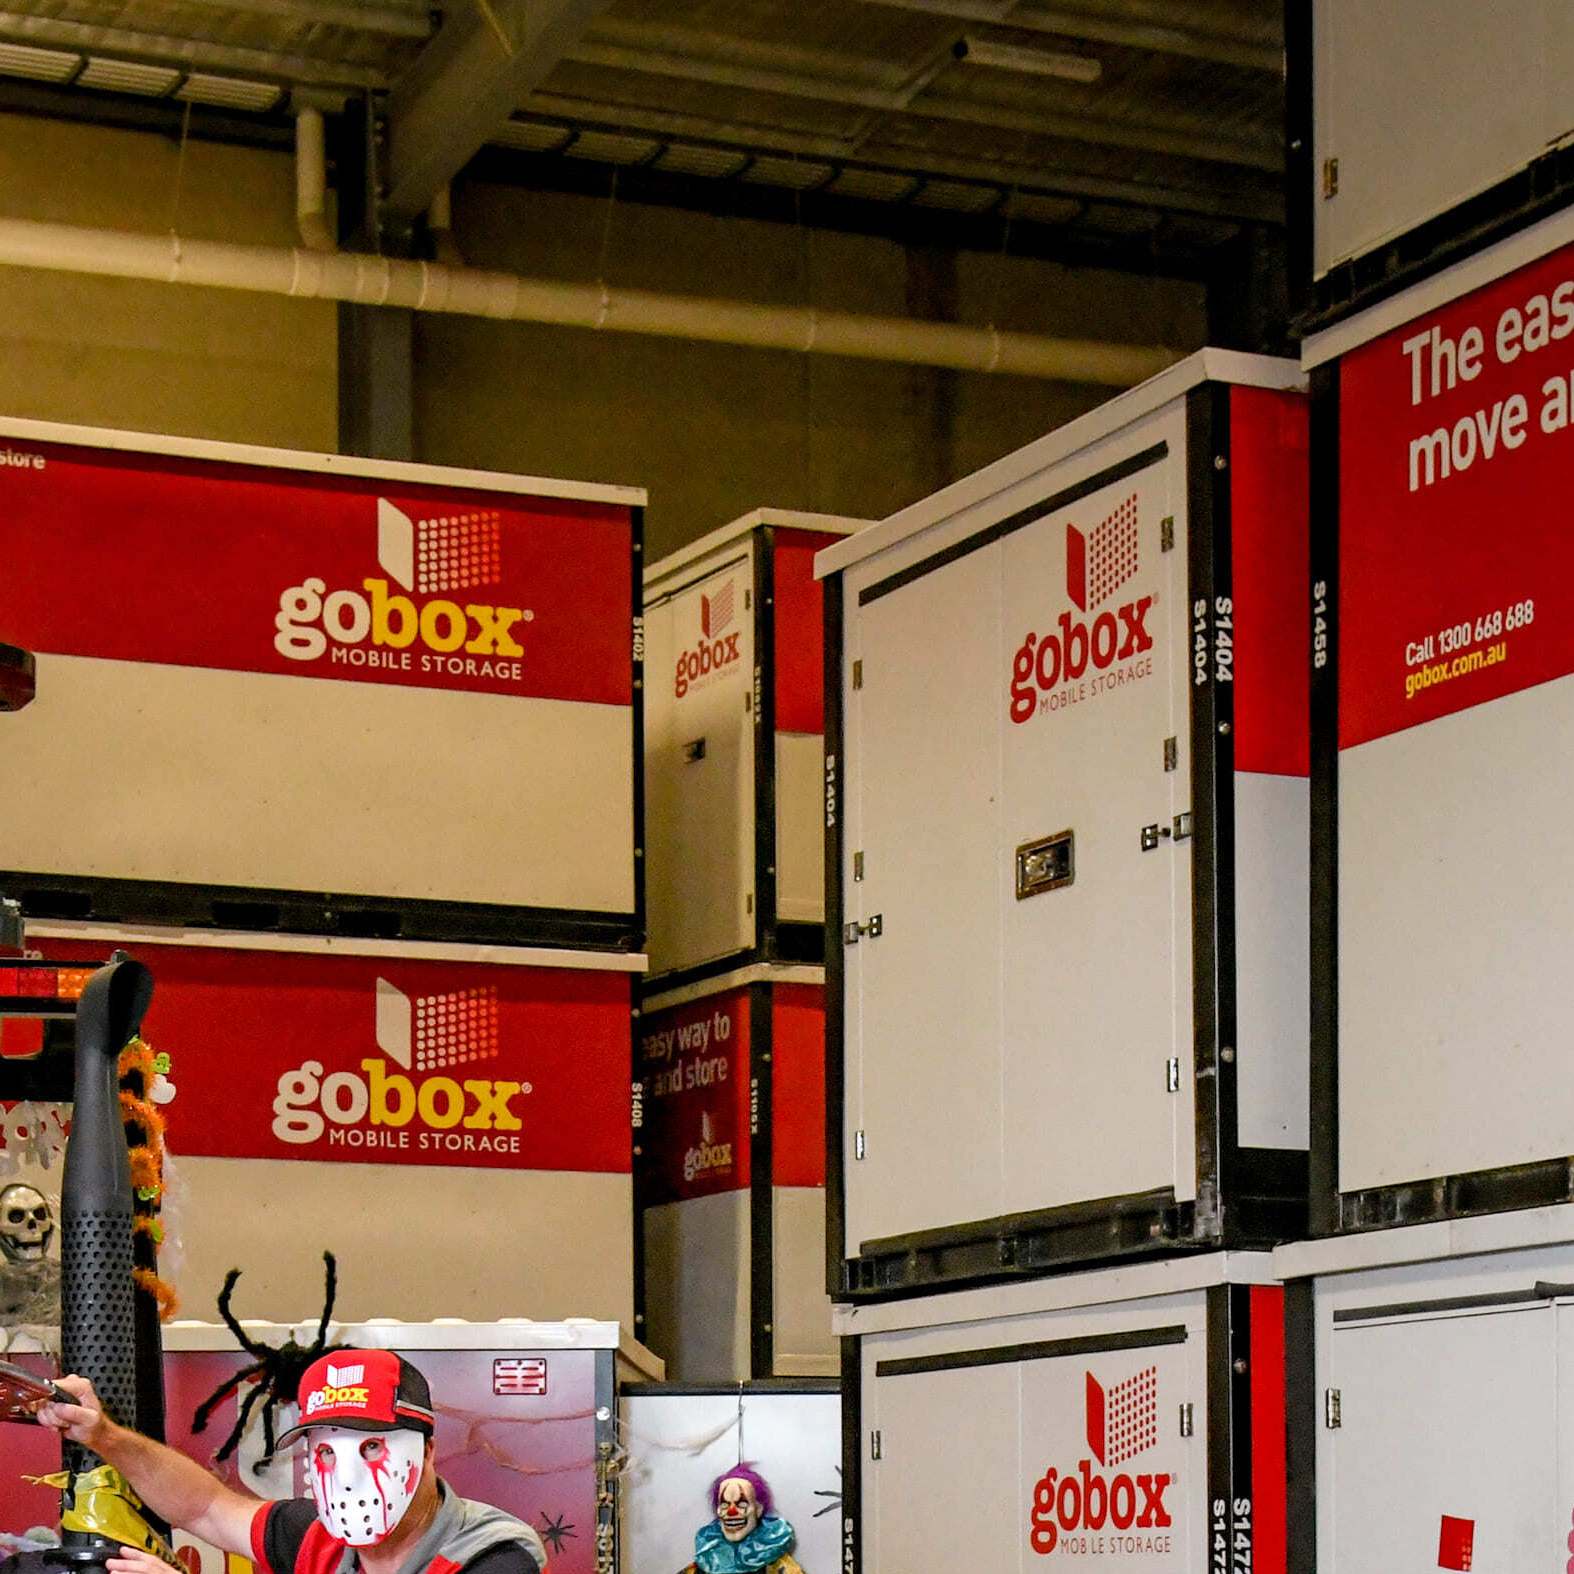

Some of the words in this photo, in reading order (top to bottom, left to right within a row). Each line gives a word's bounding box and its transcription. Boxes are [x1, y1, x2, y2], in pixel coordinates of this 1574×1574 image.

[1403, 325, 1483, 406] The
[1408, 392, 1527, 492] move
[274, 577, 523, 659] gobox
[1194, 599, 1207, 686] S1404
[1215, 596, 1234, 683] S1404
[1313, 580, 1327, 669] S1458
[1405, 638, 1435, 667] Call
[1438, 624, 1471, 655] 1300
[1474, 613, 1504, 644] 668
[1505, 599, 1535, 634] 688
[332, 646, 411, 670] MOBILE
[421, 655, 522, 680] STORAGE
[675, 632, 740, 698] gobox
[1010, 596, 1153, 724] gobox
[1039, 684, 1086, 716] MOBILE
[1091, 658, 1153, 697] STORAGE
[1405, 642, 1507, 699] gobox.com.au
[825, 755, 835, 828] S1404
[677, 1019, 711, 1054] way
[714, 1011, 731, 1042] to
[271, 1058, 522, 1144] gobox
[654, 1059, 683, 1096] and
[686, 1056, 728, 1090] store
[329, 1129, 410, 1150] MOBILE
[419, 1132, 521, 1154] STORAGE
[684, 1141, 732, 1182] gobox
[306, 1386, 369, 1415] gobox
[1030, 1460, 1172, 1556] gobox
[1060, 1537, 1105, 1555] MOBLE
[1110, 1536, 1171, 1555] STORAGE
